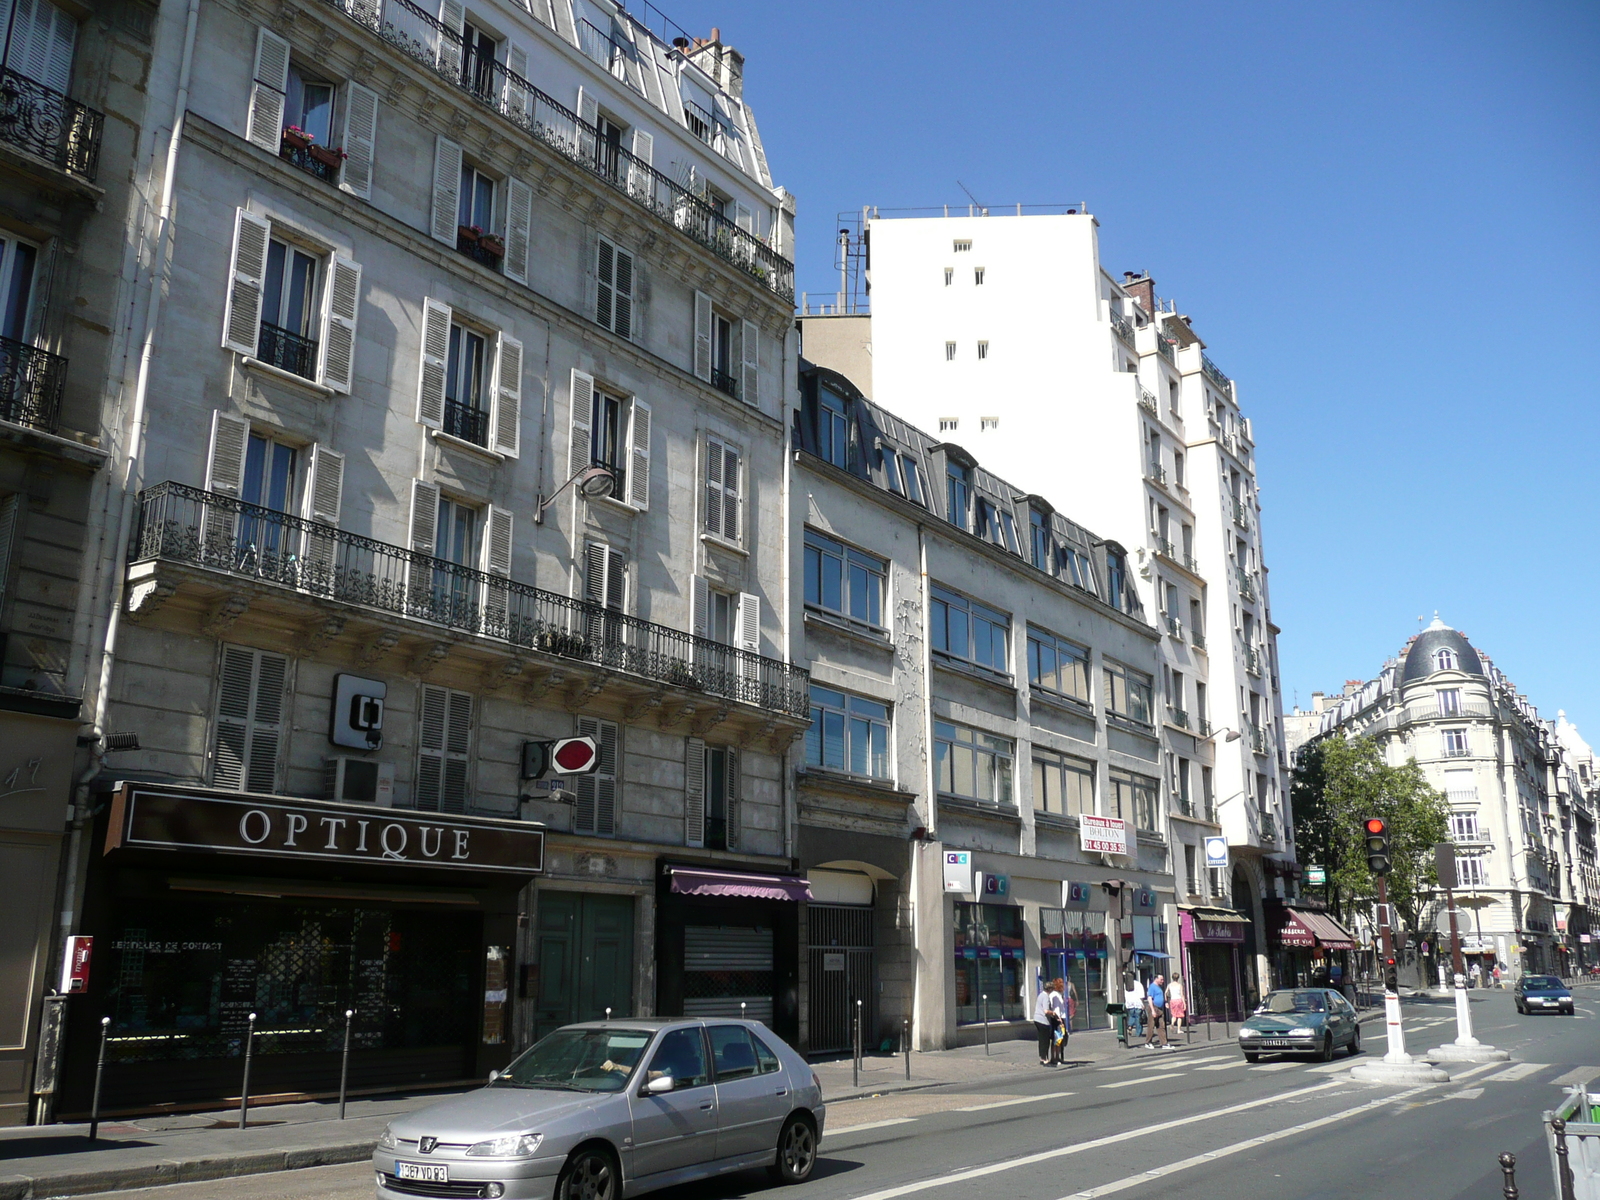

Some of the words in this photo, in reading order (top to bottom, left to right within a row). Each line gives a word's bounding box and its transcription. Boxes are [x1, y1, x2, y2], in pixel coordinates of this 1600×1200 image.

[1083, 816, 1104, 827] Bureaux
[239, 809, 470, 860] OPTIQUE
[1089, 827, 1119, 838] BOLTON
[1085, 840, 1092, 849] 01
[949, 854, 966, 863] CIC
[987, 877, 1005, 892] CIC
[1072, 886, 1087, 899] CIC
[1141, 893, 1154, 905] CIC
